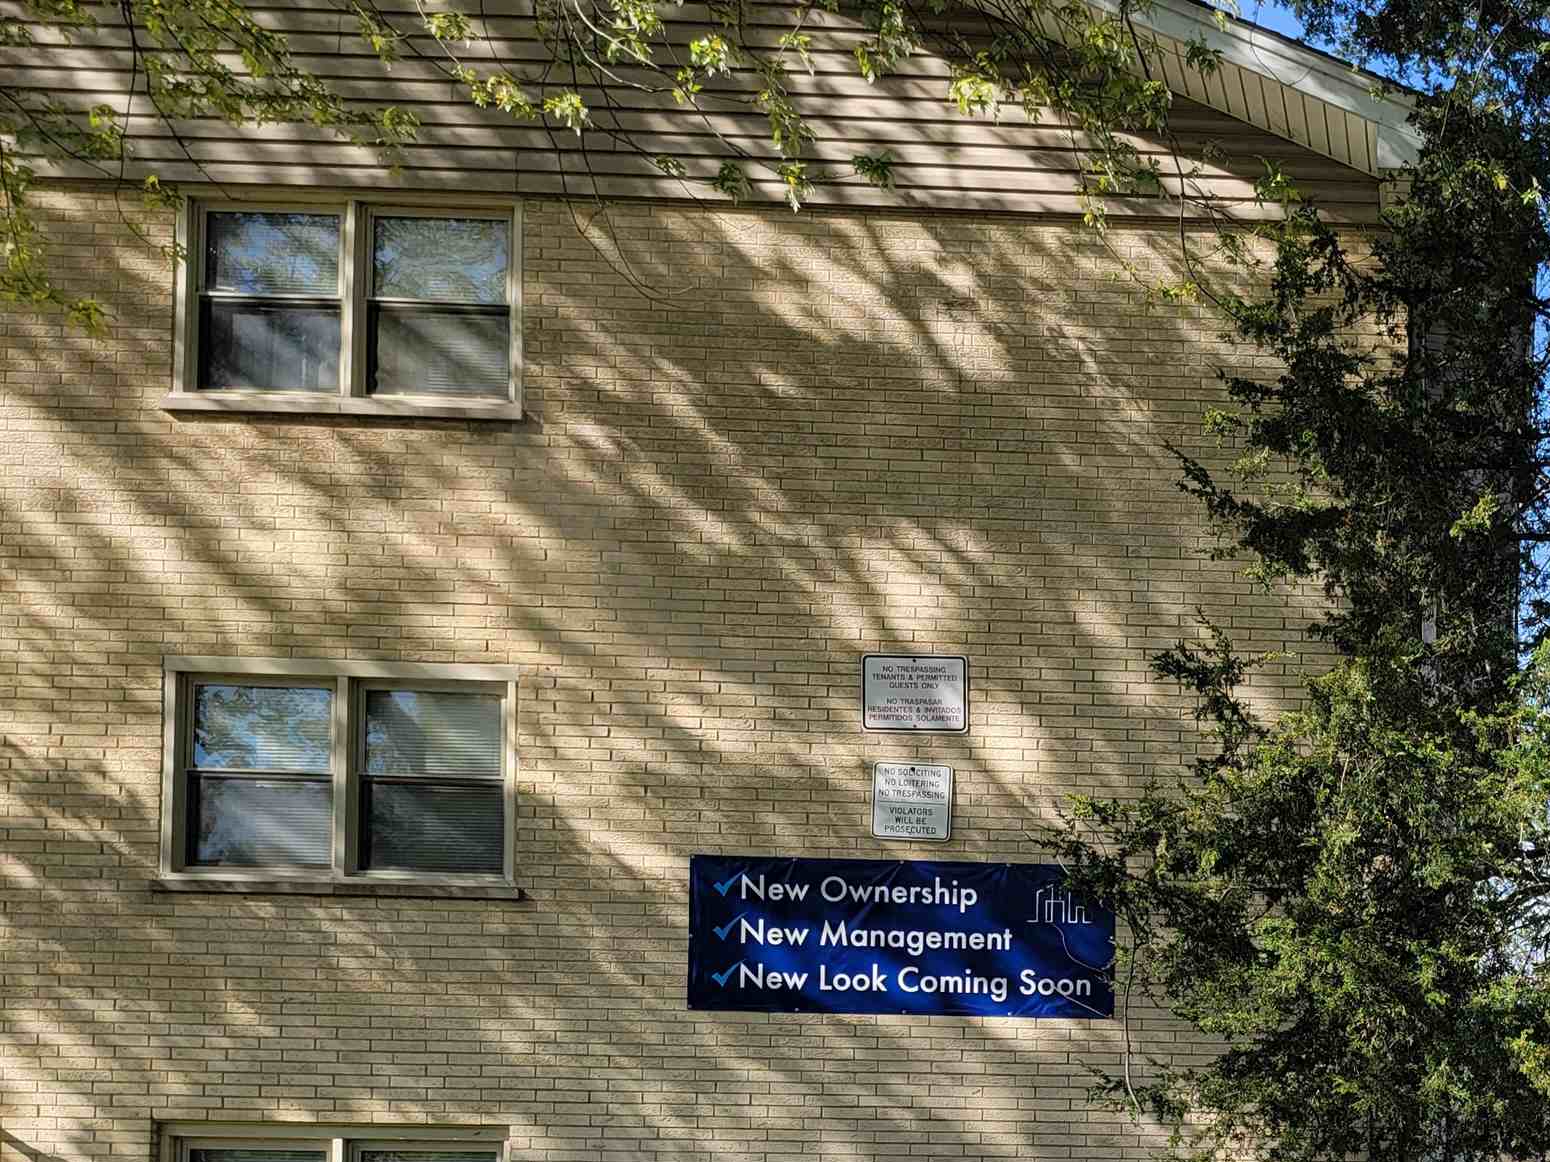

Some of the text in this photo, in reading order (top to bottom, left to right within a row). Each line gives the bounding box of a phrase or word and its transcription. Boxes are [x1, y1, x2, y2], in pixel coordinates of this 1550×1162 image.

[872, 673, 905, 681] TENANTS
[916, 674, 958, 682] PERMITTED
[868, 704, 912, 713] RESIDENTES
[869, 713, 960, 722] PERMITIDOS SOLAMENTE
[898, 768, 942, 777] SOLICITING
[885, 778, 940, 788] NO LOITERING
[879, 788, 945, 800] NO TRESPASSING
[889, 807, 933, 816] VIOLATORS
[895, 816, 928, 825] WILL BE
[884, 824, 937, 834] PROSECUTED
[741, 874, 978, 913] New Ownership
[740, 918, 1013, 956] New Management
[739, 963, 1092, 1000] New Look Coming Soon
